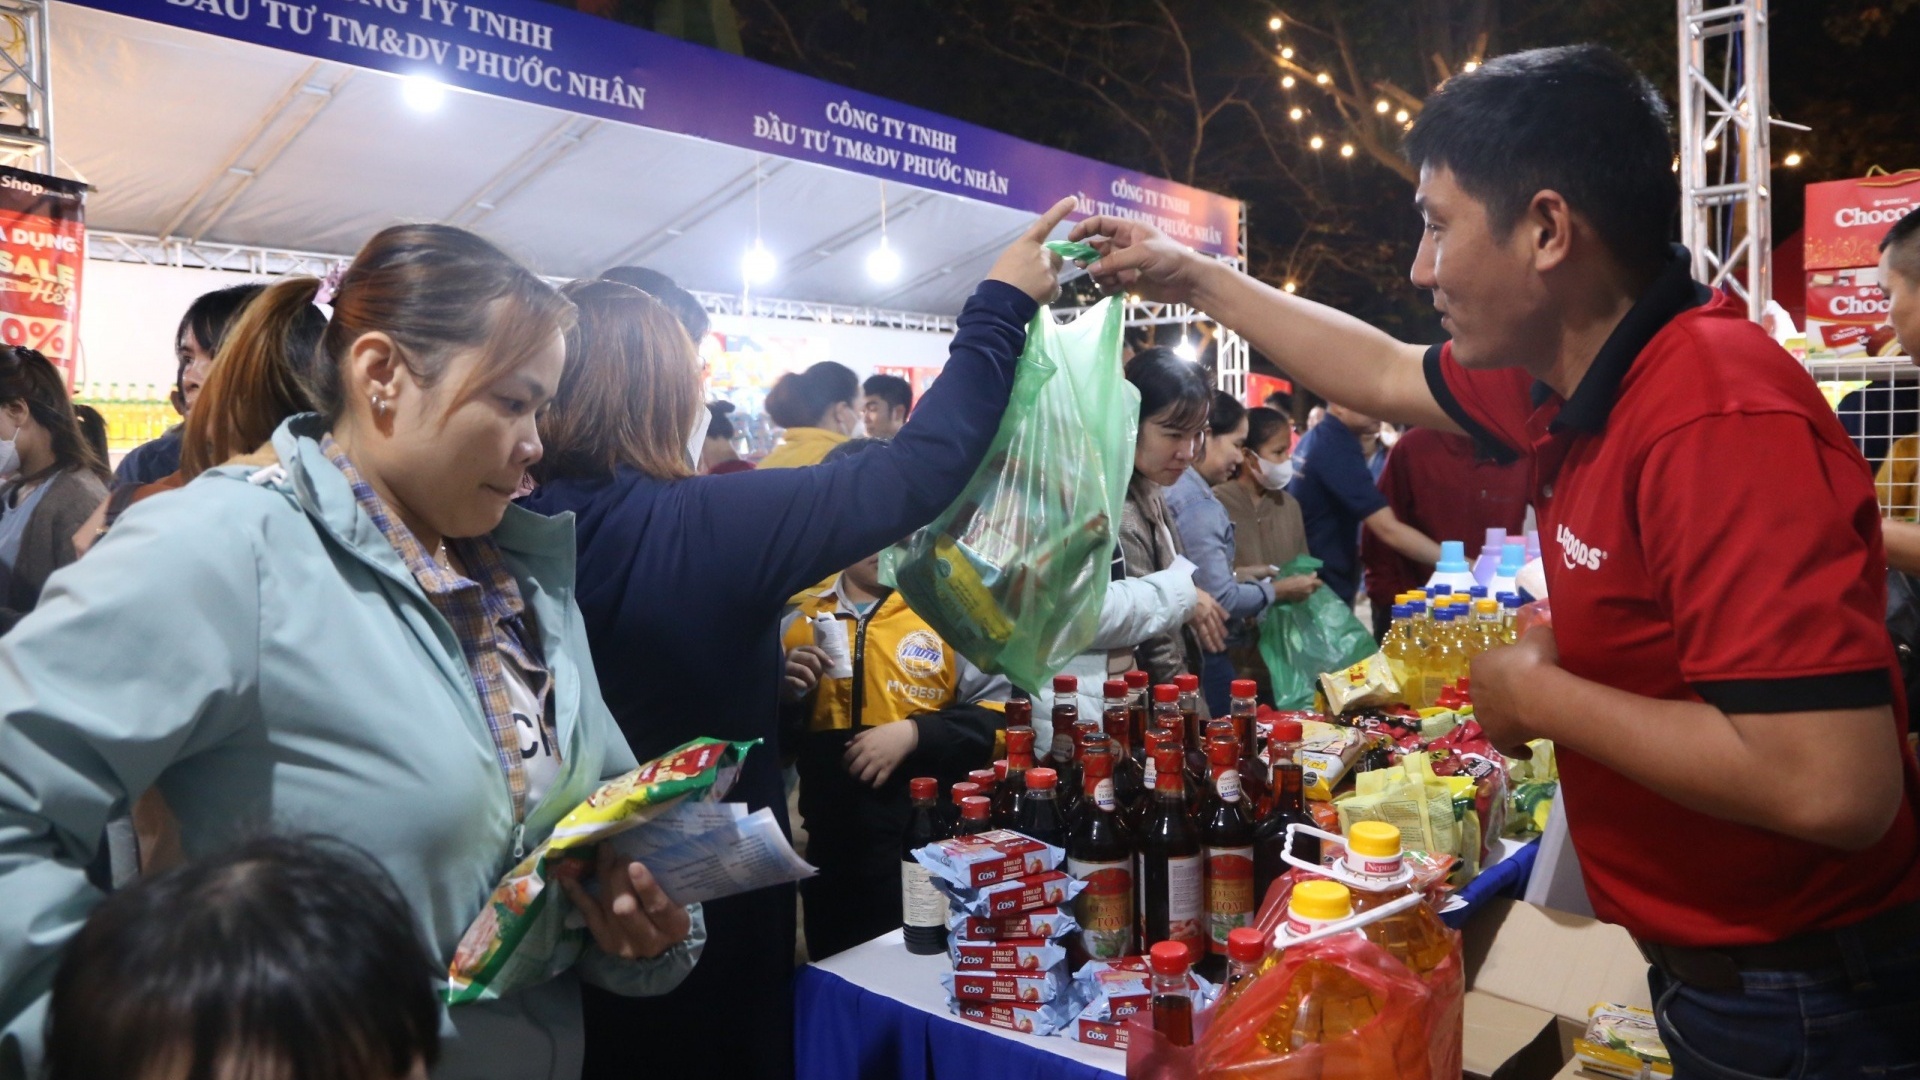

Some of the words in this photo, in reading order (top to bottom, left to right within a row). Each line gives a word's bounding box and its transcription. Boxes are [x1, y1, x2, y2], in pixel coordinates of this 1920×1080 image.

[464, 5, 553, 51] TNHH
[261, 0, 318, 35] TƯ
[323, 12, 451, 66] TM&DV
[457, 44, 562, 93] PHƯỚC
[567, 71, 647, 111] NHÂN
[825, 100, 879, 133] CÔNG
[881, 116, 906, 140] TY
[907, 124, 957, 154] TNHH
[753, 111, 797, 145] ĐẦU
[800, 127, 830, 152] TƯ
[832, 135, 901, 169] TM&DV
[902, 151, 962, 184] PHƯỚC
[963, 169, 1009, 196] NHÂN
[1111, 178, 1143, 203] CÔNG
[1144, 189, 1159, 207] TY
[1160, 193, 1190, 215] TNHH
[12, 227, 77, 254] DỤNG
[0, 250, 75, 288] SALE
[978, 871, 997, 881] COSY
[997, 900, 1016, 910] COSY
[975, 926, 996, 934] COSY
[962, 956, 984, 964] COSY
[963, 985, 985, 994] COSY
[966, 1007, 985, 1018] COSY
[1116, 1006, 1138, 1016] COSY
[1087, 1030, 1108, 1041] COSY
